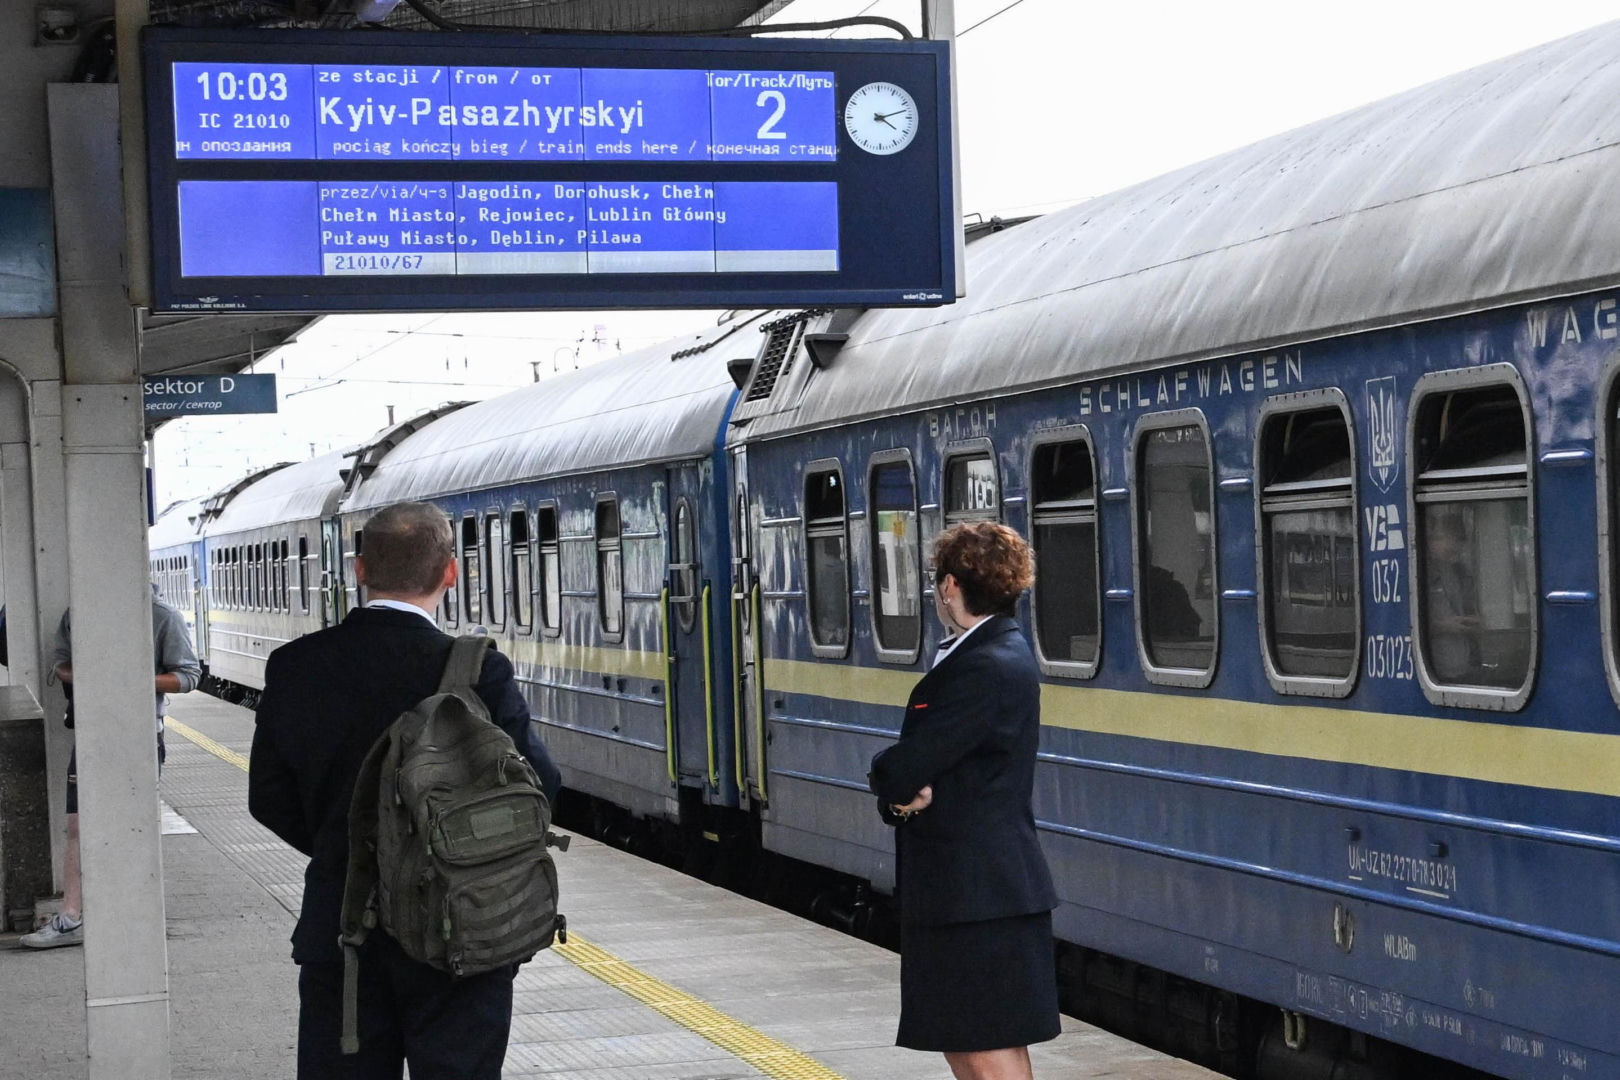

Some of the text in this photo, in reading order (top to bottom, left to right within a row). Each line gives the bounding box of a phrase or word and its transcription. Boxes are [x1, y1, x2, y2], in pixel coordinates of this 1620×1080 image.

[320, 72, 340, 82] ze
[354, 69, 418, 84] stacji
[456, 70, 497, 84] from
[198, 72, 287, 100] 10:03
[200, 113, 289, 128] IC 21010
[320, 97, 642, 133] Kyiv-Pasazhyrskyi
[756, 91, 786, 139] 2
[334, 139, 391, 155] pociąg
[402, 139, 460, 156] kończy
[471, 140, 508, 156] bieg
[538, 140, 583, 153] train
[596, 140, 632, 154] ends
[642, 141, 678, 154] here
[707, 145, 779, 154] конечная
[457, 185, 541, 201] Jagodin,
[555, 185, 649, 199] Dorohusk,
[663, 185, 713, 198] Chełm
[322, 207, 725, 224] Chełm Miasto, Rejowiec, Lublin Główny
[323, 230, 641, 247] Puławy Miasto, Dęblin, Pilawa
[336, 255, 422, 269] 21010/67
[144, 377, 235, 395] sektor D
[1080, 350, 1303, 416] SCHLAFWAGEN
[145, 402, 178, 410] sector
[186, 401, 222, 410] сектор
[1372, 558, 1401, 604] 032
[1367, 634, 1413, 681] 03023
